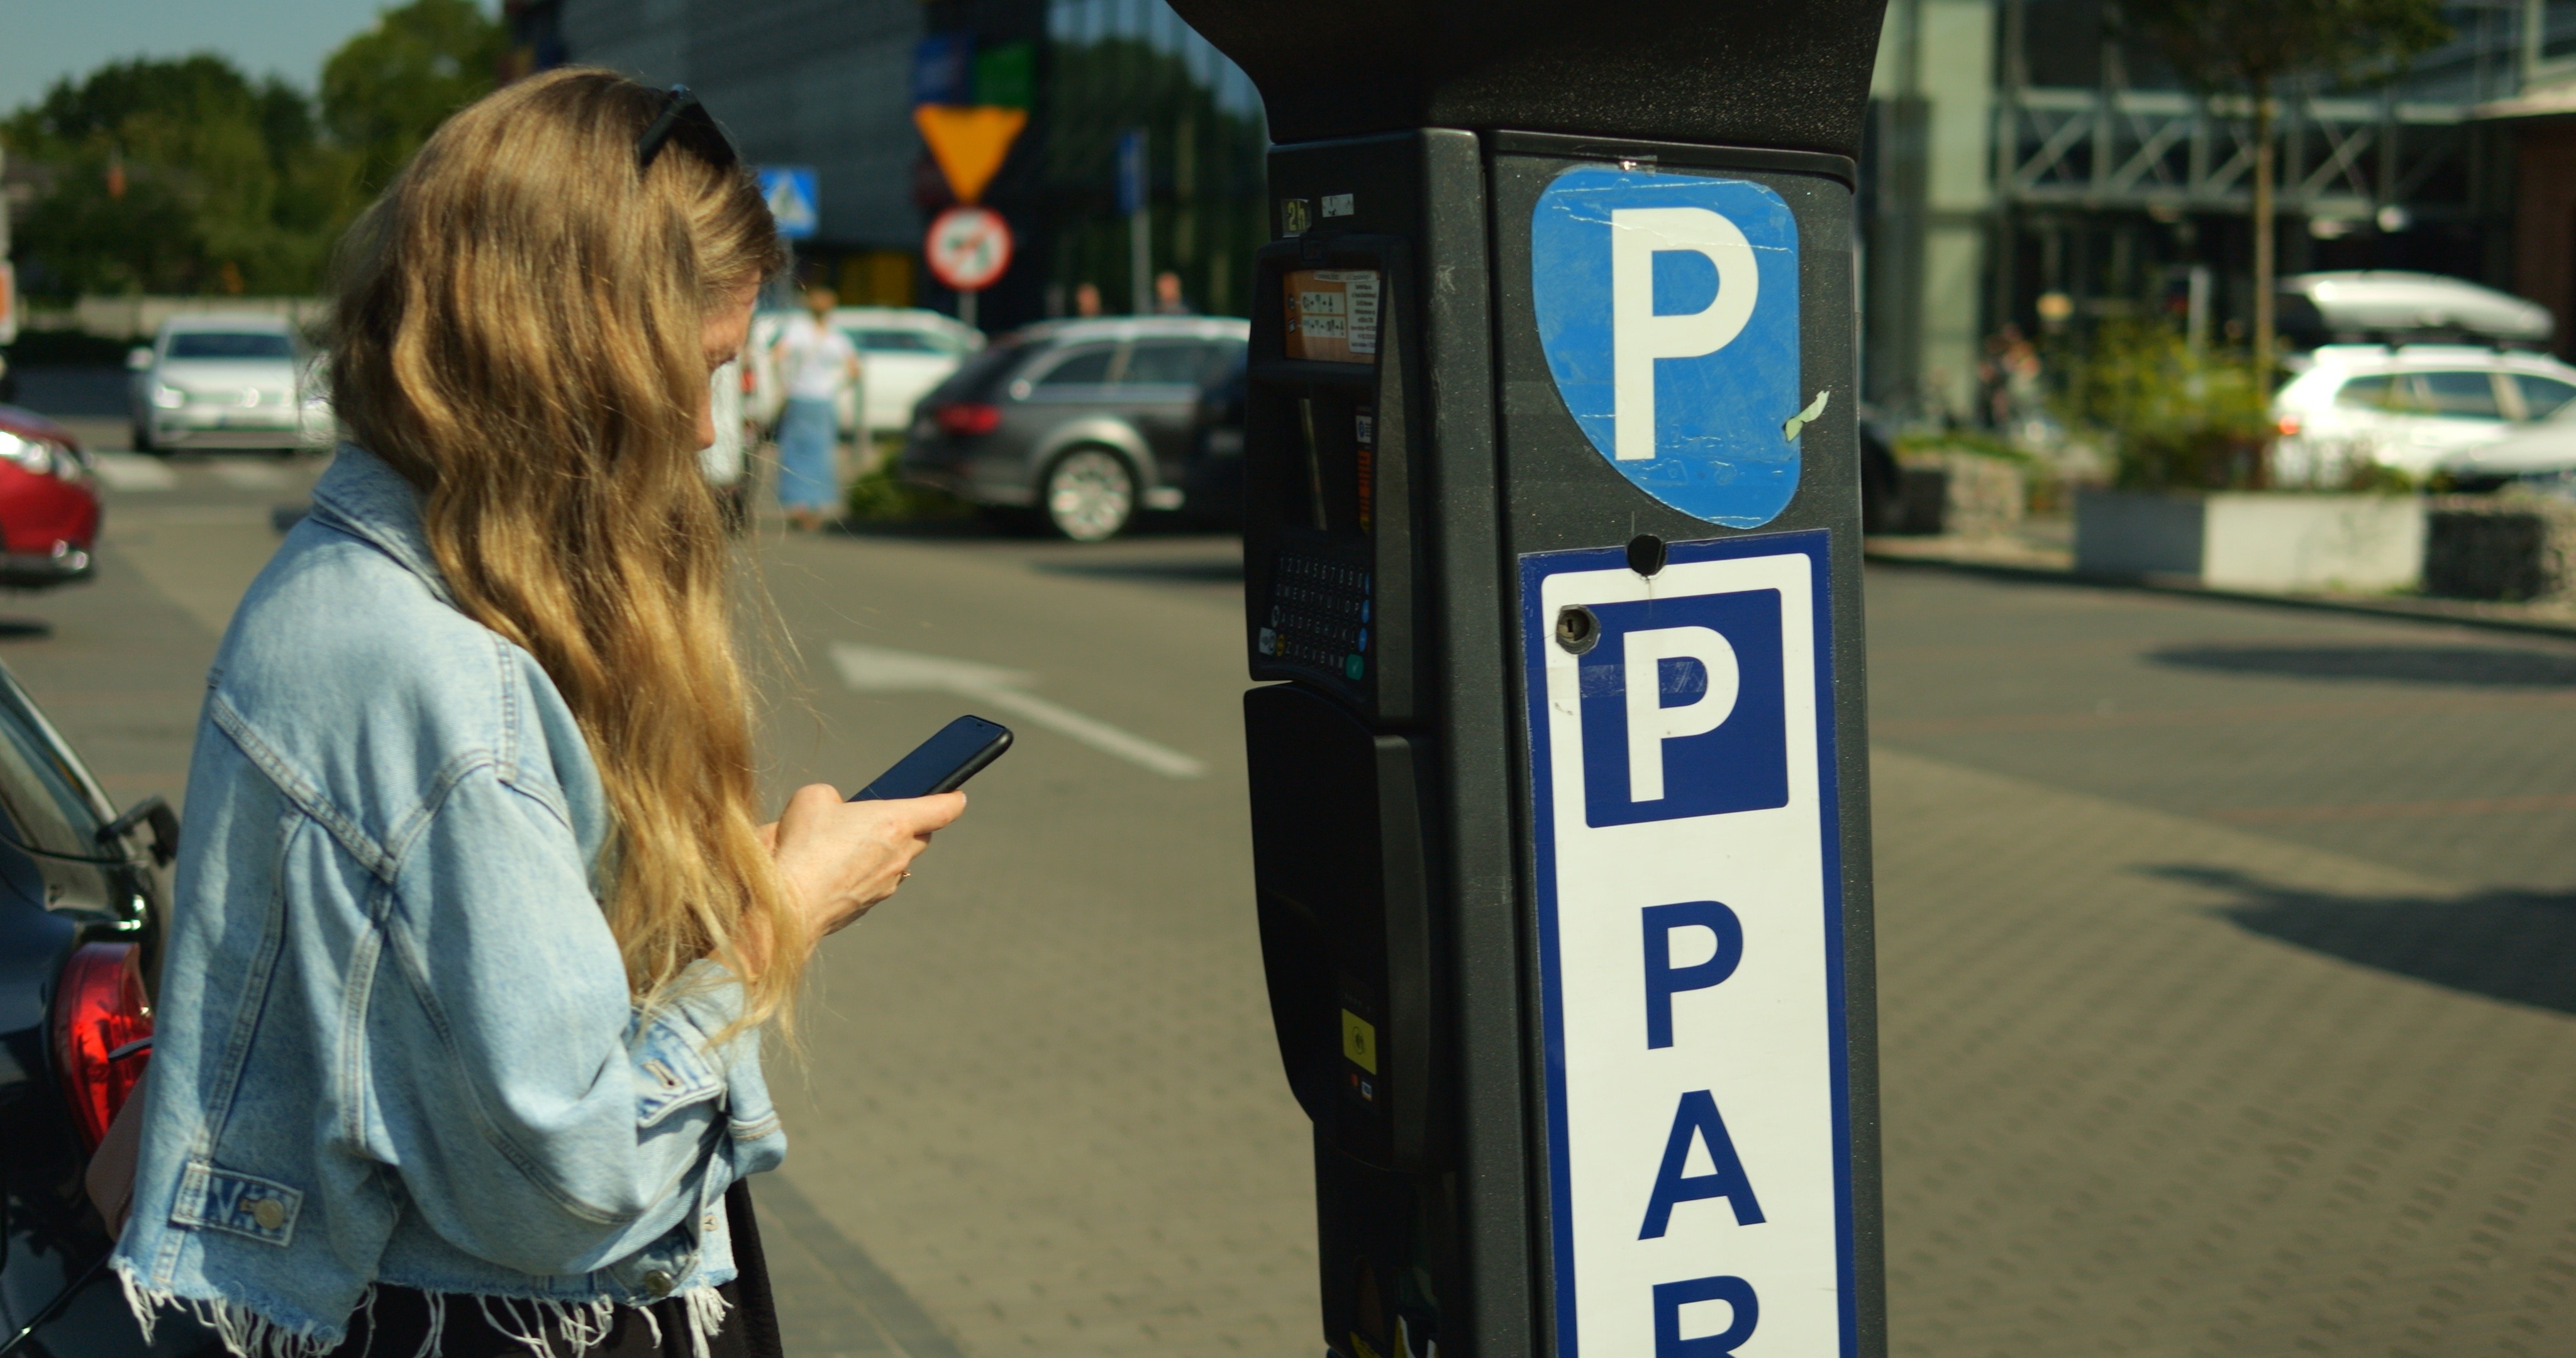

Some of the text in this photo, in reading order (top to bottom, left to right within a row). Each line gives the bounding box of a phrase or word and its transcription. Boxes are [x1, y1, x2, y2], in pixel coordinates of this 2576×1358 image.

[1287, 201, 1306, 231] 2h
[1611, 207, 1759, 460] P
[1623, 626, 1740, 803] P
[1637, 900, 1767, 1358] PAR
